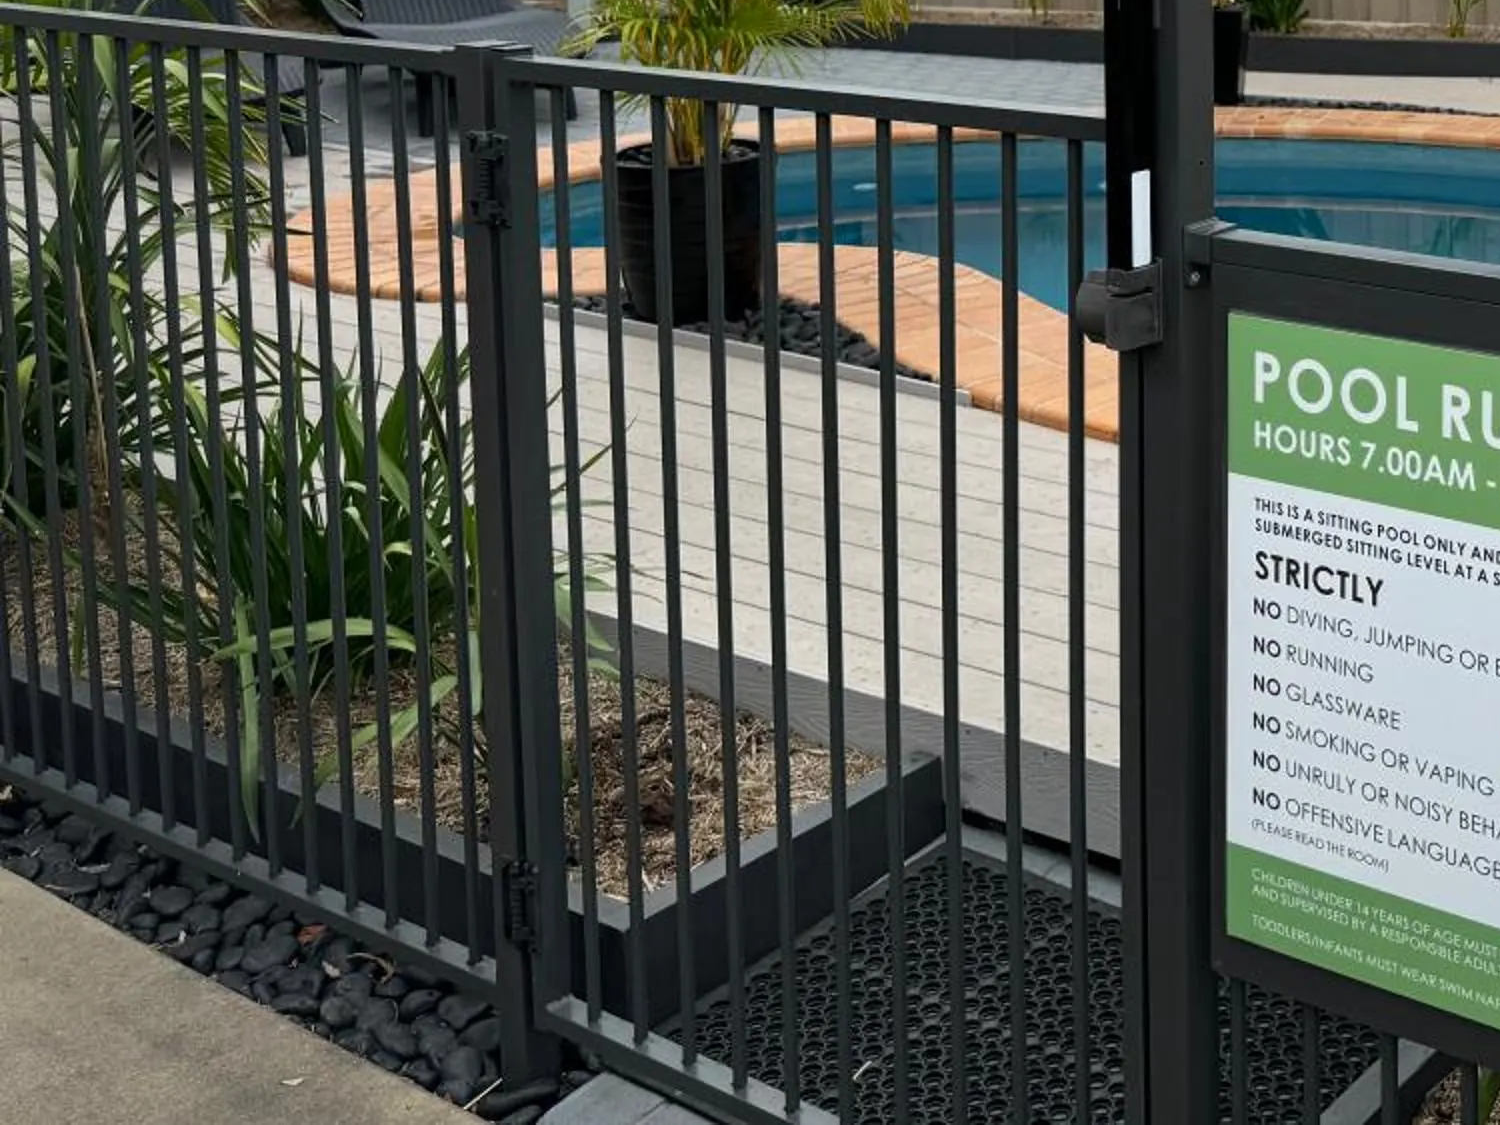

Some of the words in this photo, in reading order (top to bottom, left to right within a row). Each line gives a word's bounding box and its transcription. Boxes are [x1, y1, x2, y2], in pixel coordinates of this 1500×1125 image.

[1253, 348, 1419, 434] POOL
[1253, 419, 1351, 469] HOURS
[1360, 439, 1476, 494] 7.00AM
[1255, 496, 1283, 517] THIS
[1286, 503, 1299, 521] IS
[1303, 507, 1313, 524] A
[1317, 510, 1372, 537] SITTING
[1377, 523, 1419, 547] POOL
[1422, 532, 1466, 557] ONLY
[1255, 517, 1342, 551] SUBMERGED
[1346, 537, 1402, 565] SITTING
[1407, 551, 1450, 575] LEVEL
[1453, 561, 1473, 581] AT
[1476, 566, 1489, 584] A
[1255, 549, 1384, 609] STRICTLY
[1253, 597, 1281, 622] NO
[1287, 605, 1358, 642] DIVING,
[1362, 623, 1454, 665] JUMPING
[1458, 647, 1489, 674] OR
[1253, 634, 1281, 660] NO
[1286, 643, 1374, 684] RUNNING
[1253, 672, 1281, 698] NO
[1285, 681, 1401, 731] GLASSWARE
[1252, 748, 1280, 775] NO
[1285, 757, 1356, 797] UNRULY
[1360, 779, 1389, 807] OR
[1394, 789, 1453, 826] NOISY
[1253, 710, 1281, 736] NO
[1285, 719, 1375, 763] SMOKING
[1380, 745, 1409, 773] OR
[1415, 755, 1495, 797] VAPING
[1252, 786, 1280, 813] NO
[1285, 795, 1383, 844] OFFENSIVE
